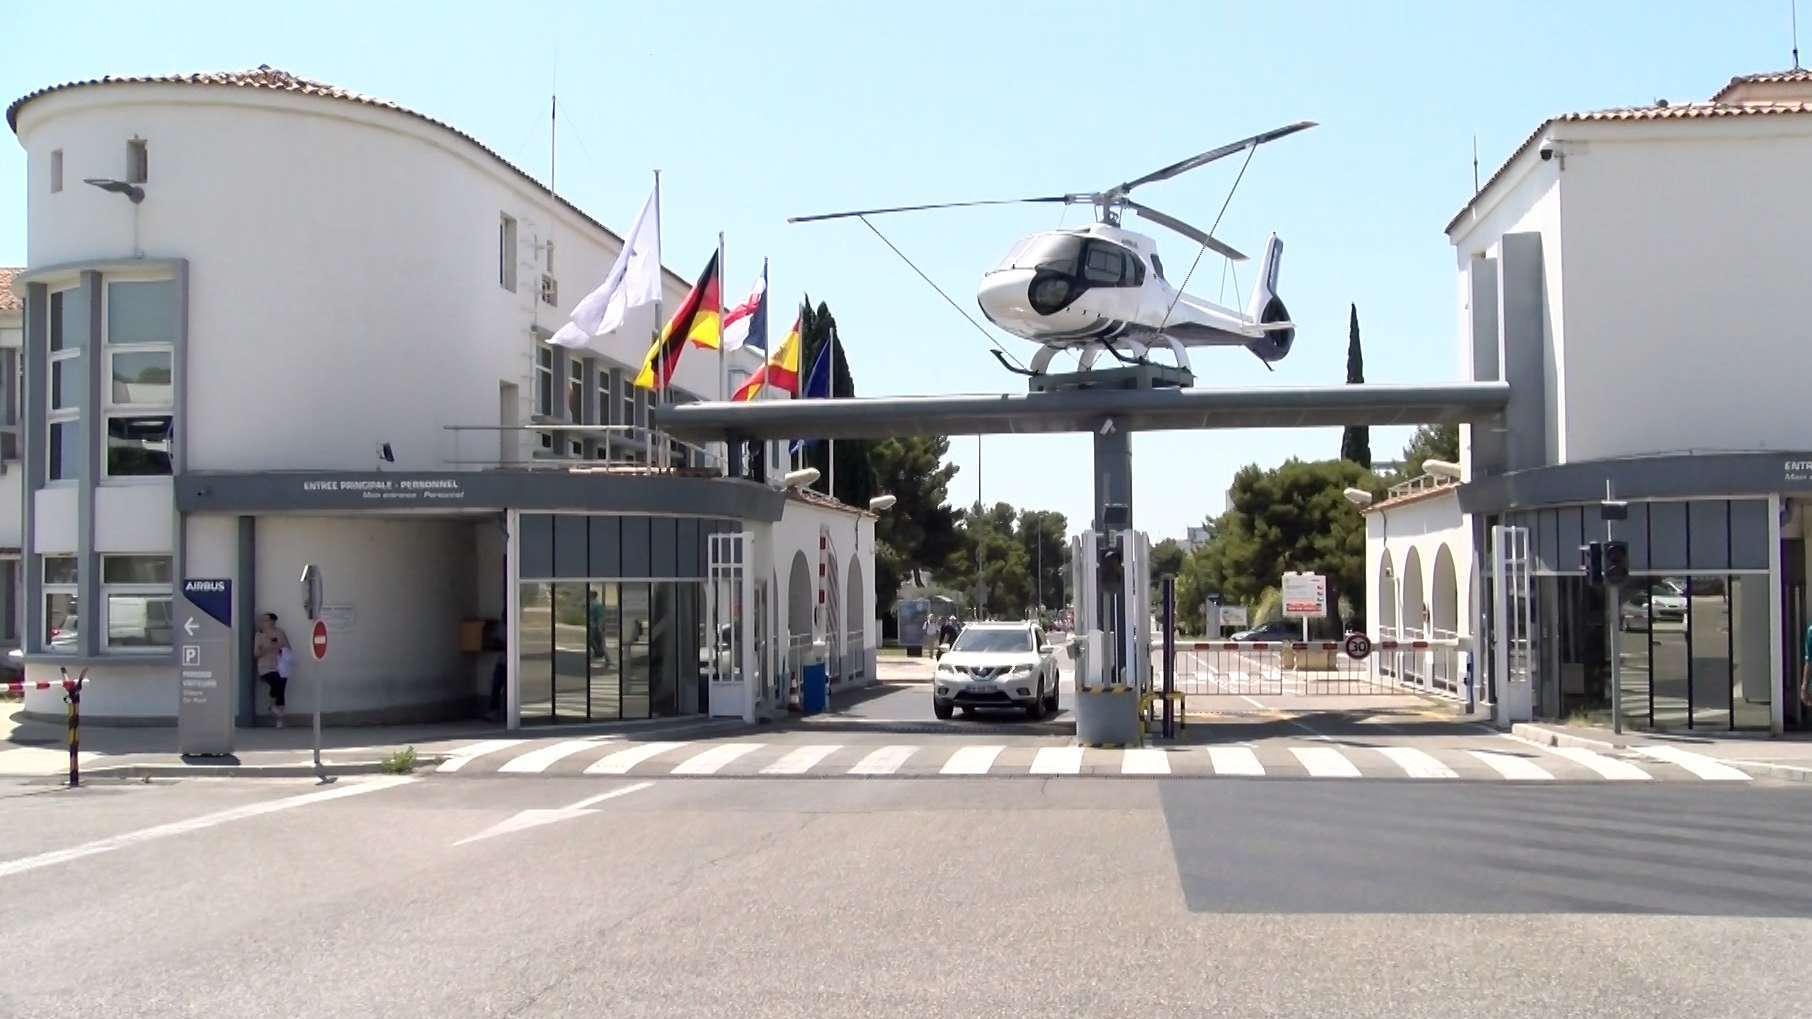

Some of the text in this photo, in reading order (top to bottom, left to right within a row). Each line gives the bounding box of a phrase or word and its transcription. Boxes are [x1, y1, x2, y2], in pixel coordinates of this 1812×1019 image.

[400, 480, 458, 488] PERSONNEL
[185, 581, 225, 592] AIRBUS
[1351, 640, 1366, 652] 30
